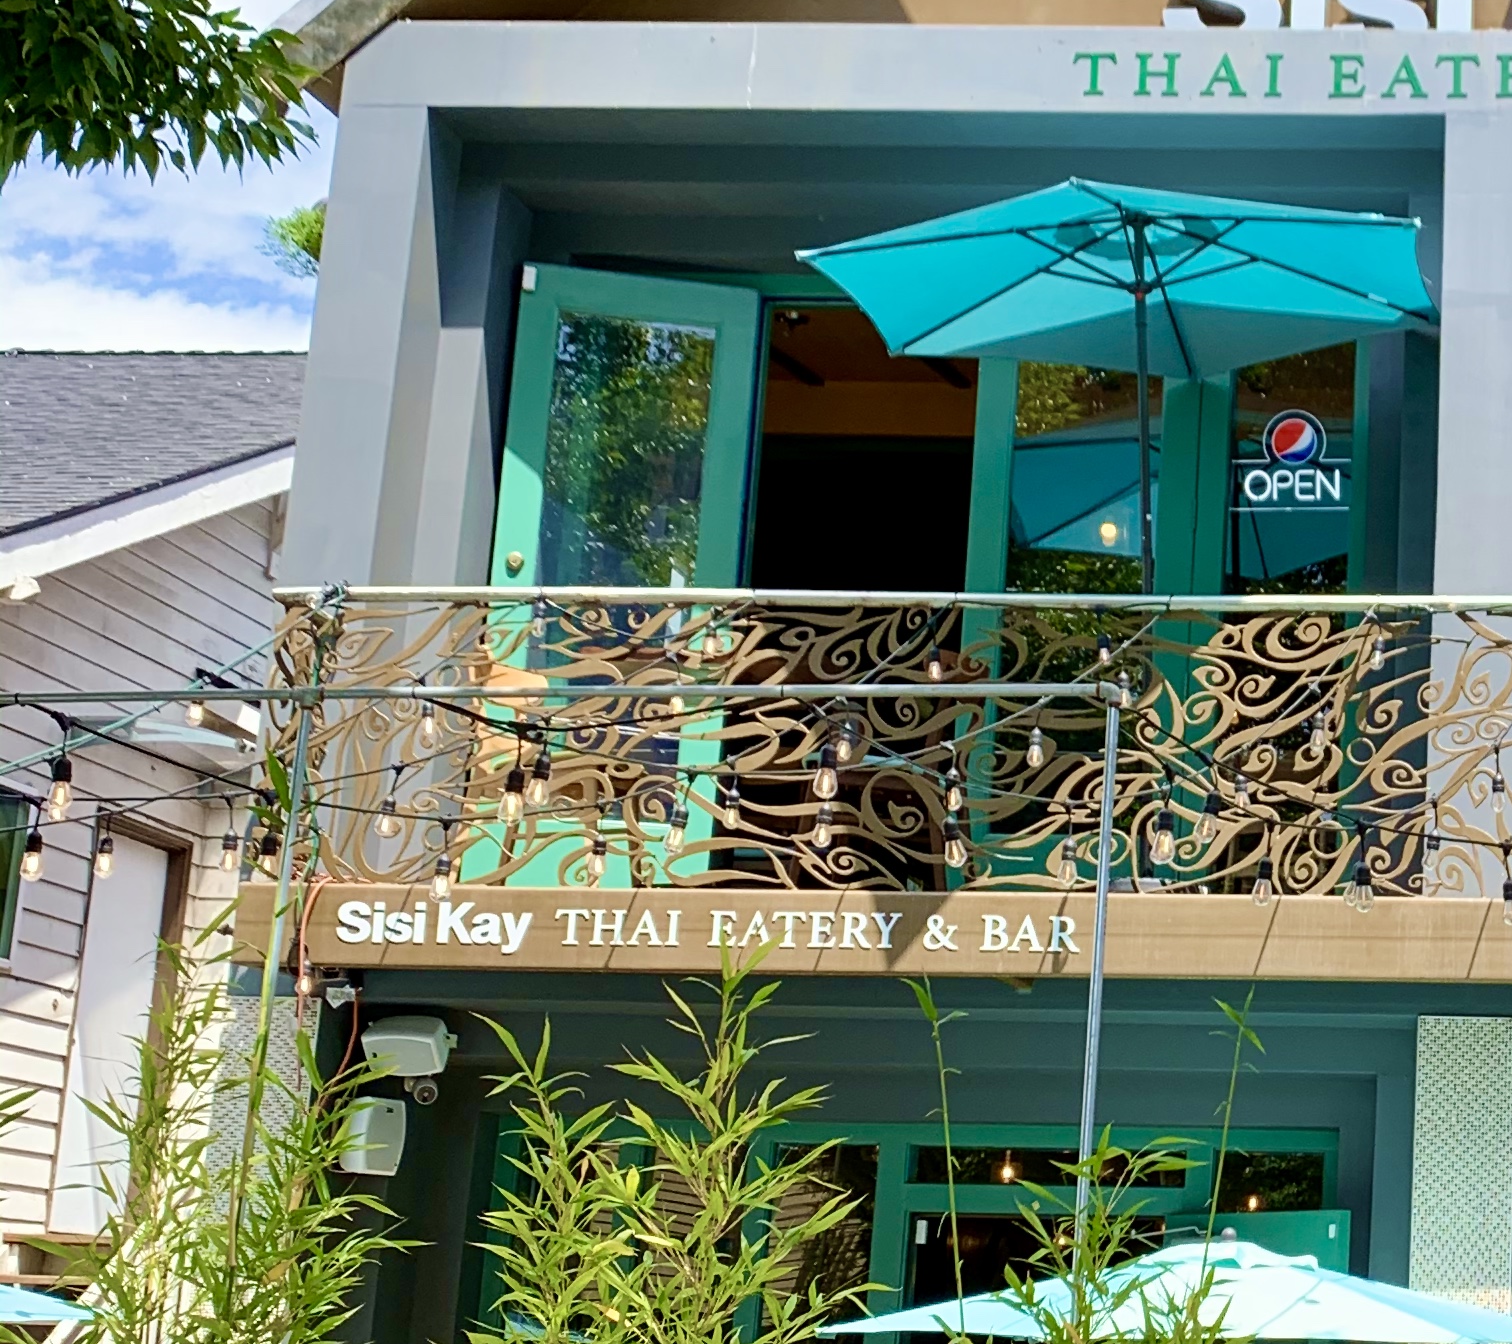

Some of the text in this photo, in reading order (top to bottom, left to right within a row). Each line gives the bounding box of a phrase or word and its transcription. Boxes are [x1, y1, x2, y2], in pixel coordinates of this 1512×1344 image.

[1074, 52, 1283, 98] THAI
[1244, 468, 1341, 502] OPEN
[336, 900, 1081, 954] Sisi Kay THAI EATERY & BAR
